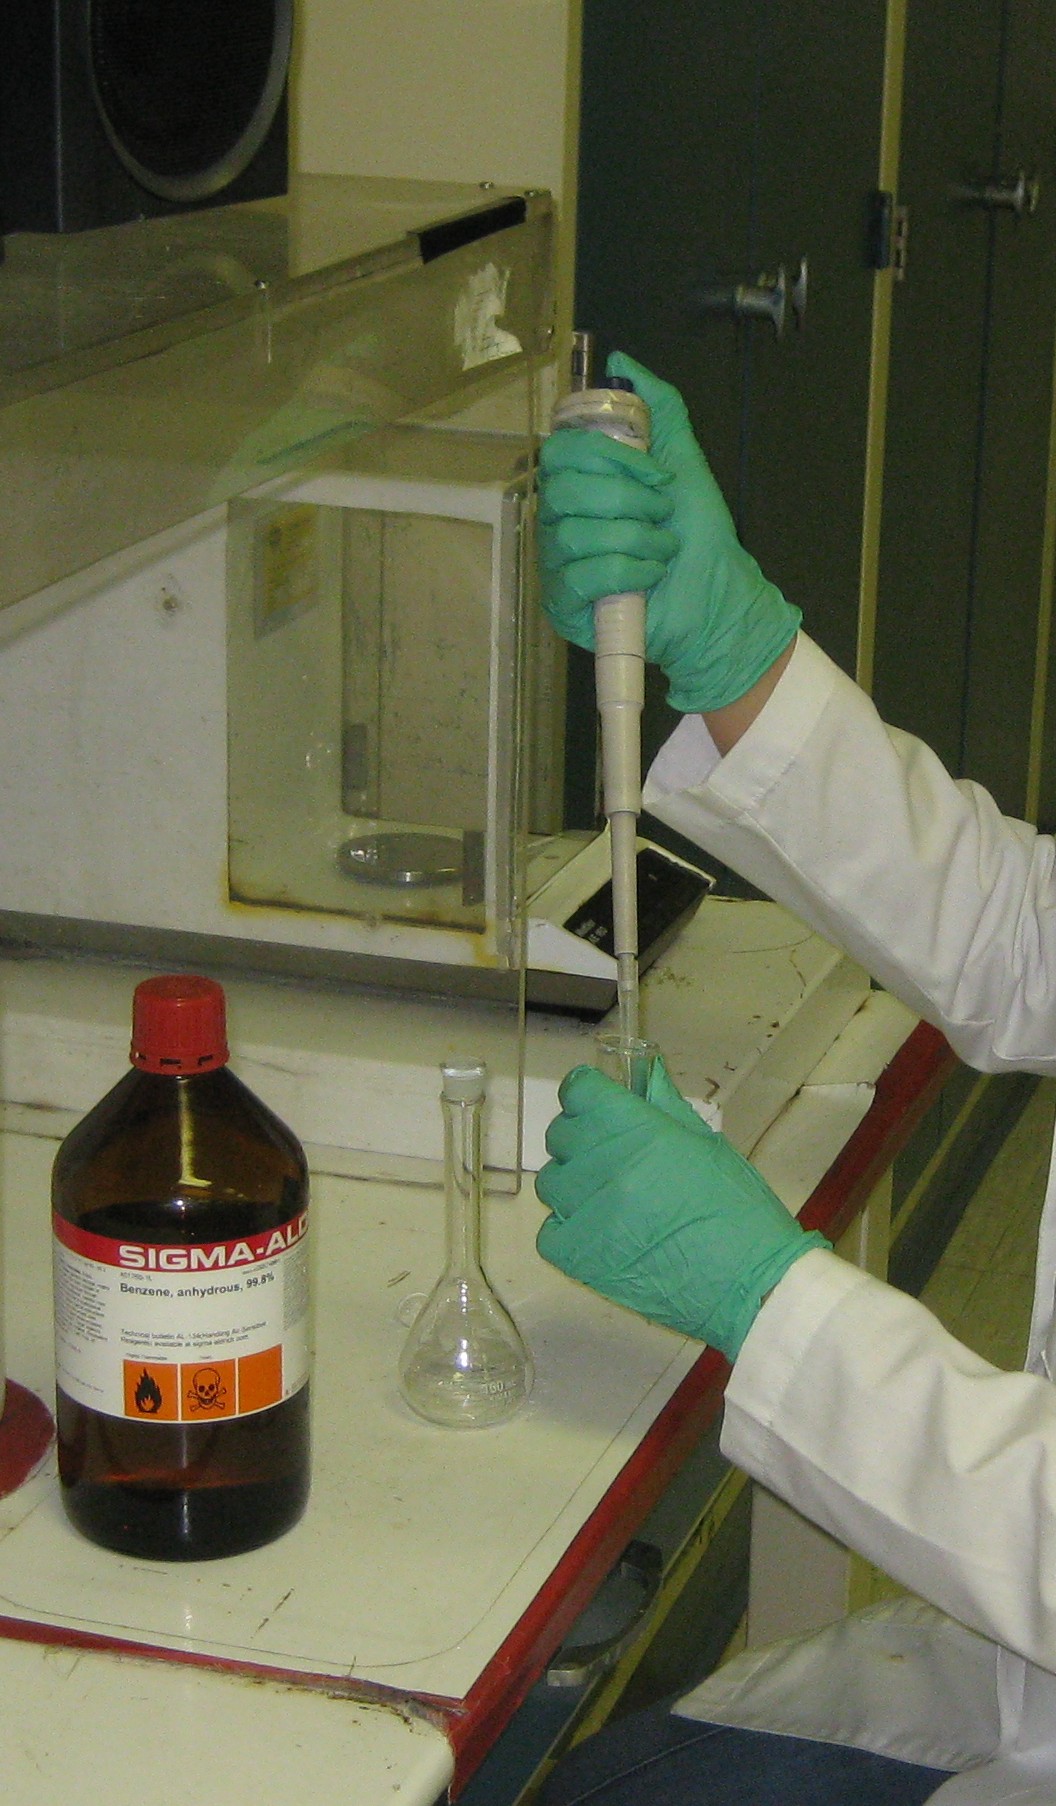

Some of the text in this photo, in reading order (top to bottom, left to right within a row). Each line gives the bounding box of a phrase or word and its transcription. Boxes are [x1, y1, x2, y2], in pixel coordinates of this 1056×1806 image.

[120, 1271, 275, 1299] Benzene, anhydrous, 99.8%
